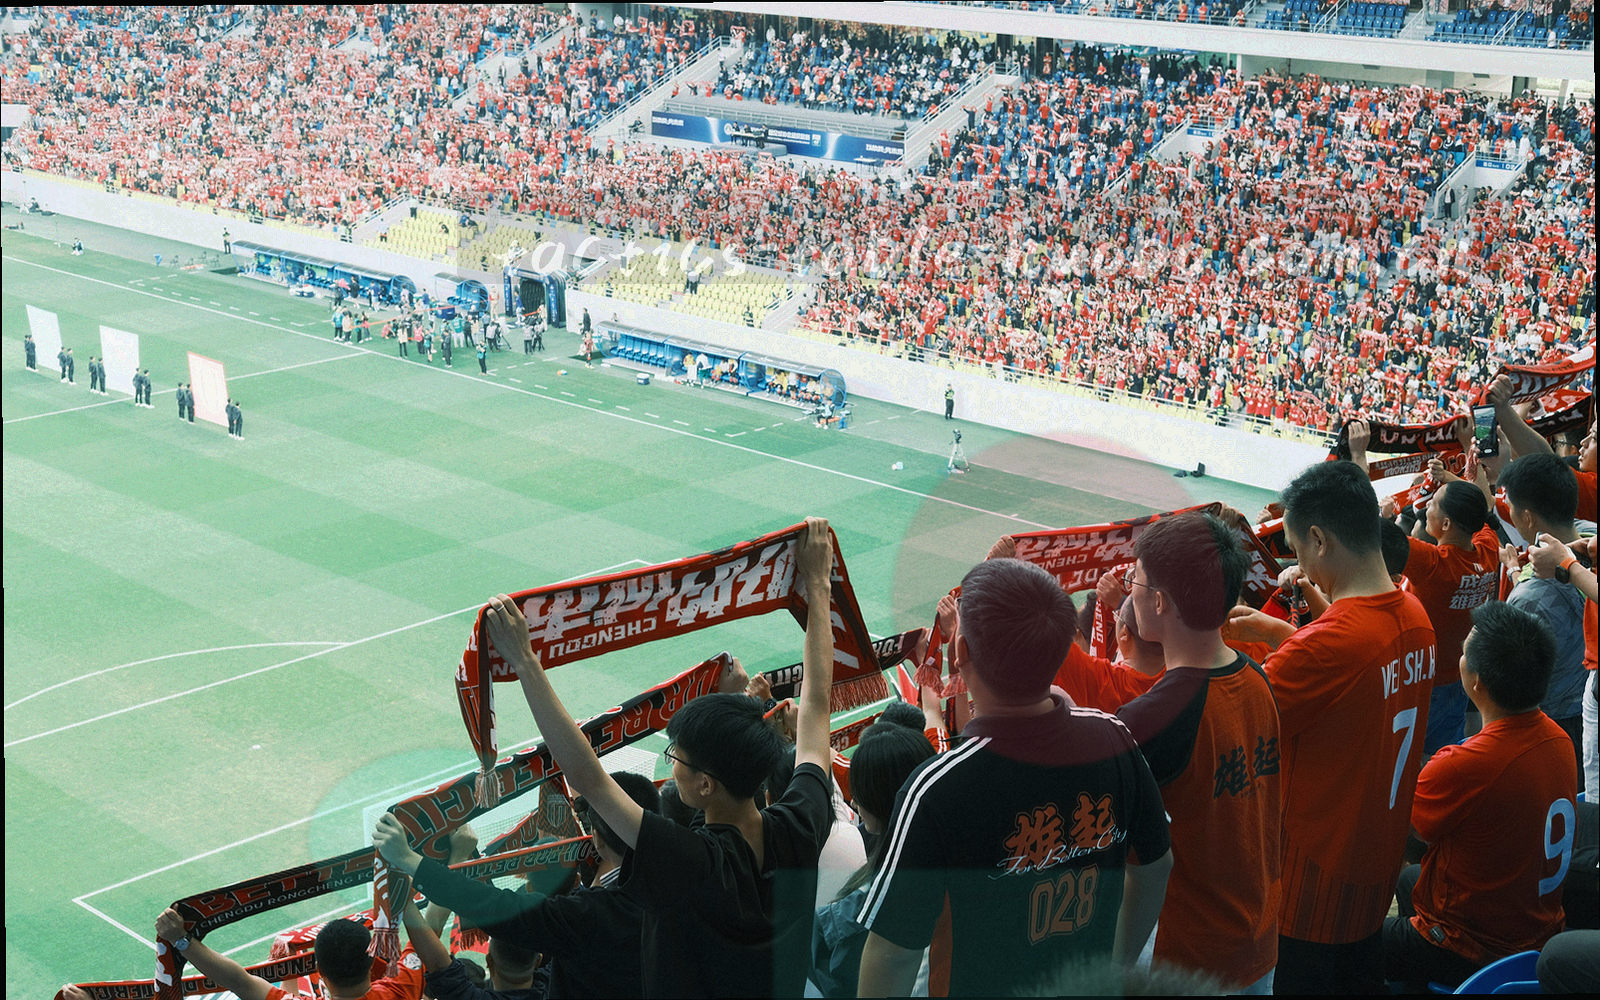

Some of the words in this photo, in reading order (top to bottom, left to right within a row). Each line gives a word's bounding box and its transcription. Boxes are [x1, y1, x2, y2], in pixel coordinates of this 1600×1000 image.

[549, 617, 657, 660] CHENGDU
[1389, 706, 1418, 810] 7
[1004, 792, 1118, 872] 雄起
[1538, 798, 1577, 897] 9
[200, 902, 264, 929] CHENGDU
[268, 876, 354, 906] RONGCHENG
[1028, 865, 1099, 945] 028
